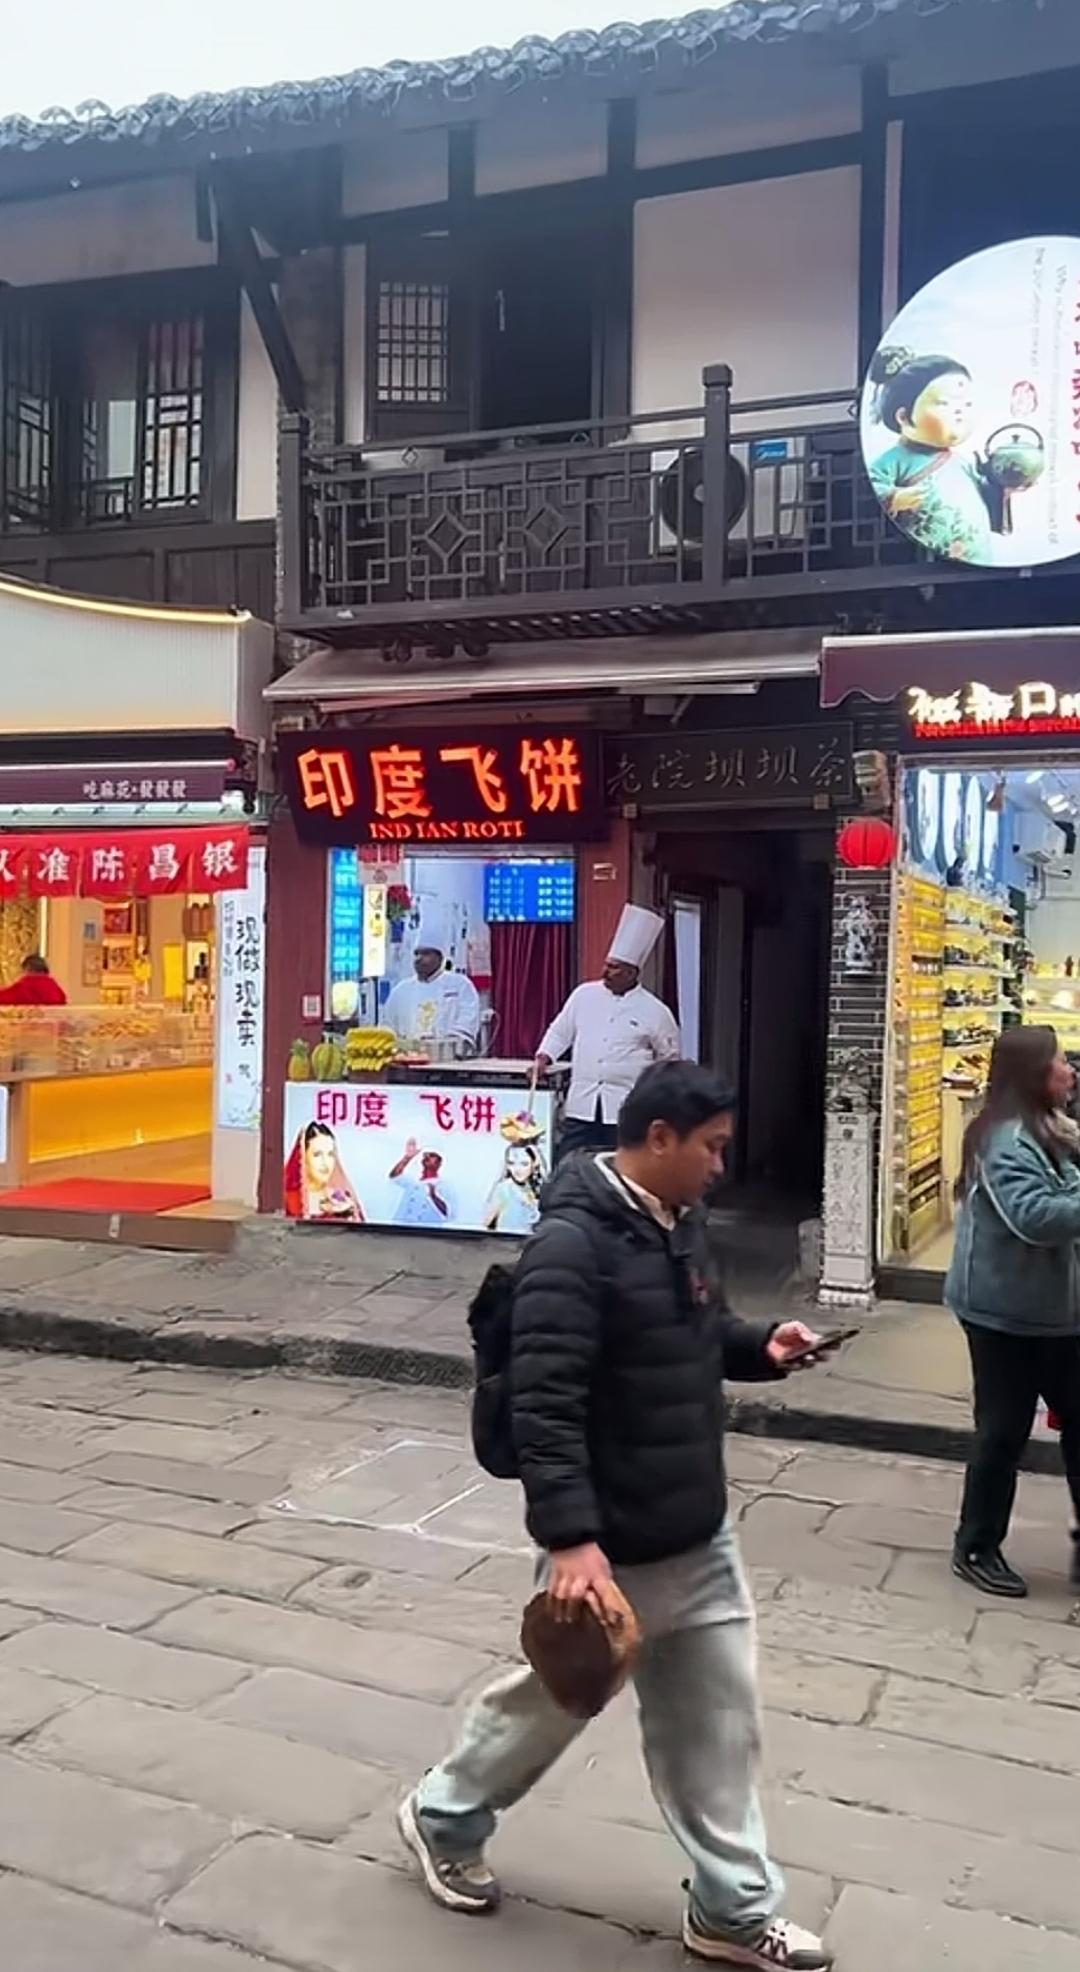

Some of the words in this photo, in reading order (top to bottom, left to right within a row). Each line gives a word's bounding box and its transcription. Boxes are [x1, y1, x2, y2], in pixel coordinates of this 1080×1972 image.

[297, 738, 582, 818] 印度飞饼
[462, 820, 523, 838] ROTI
[316, 1089, 388, 1128] 印度
[420, 1094, 496, 1132] 飞饼
